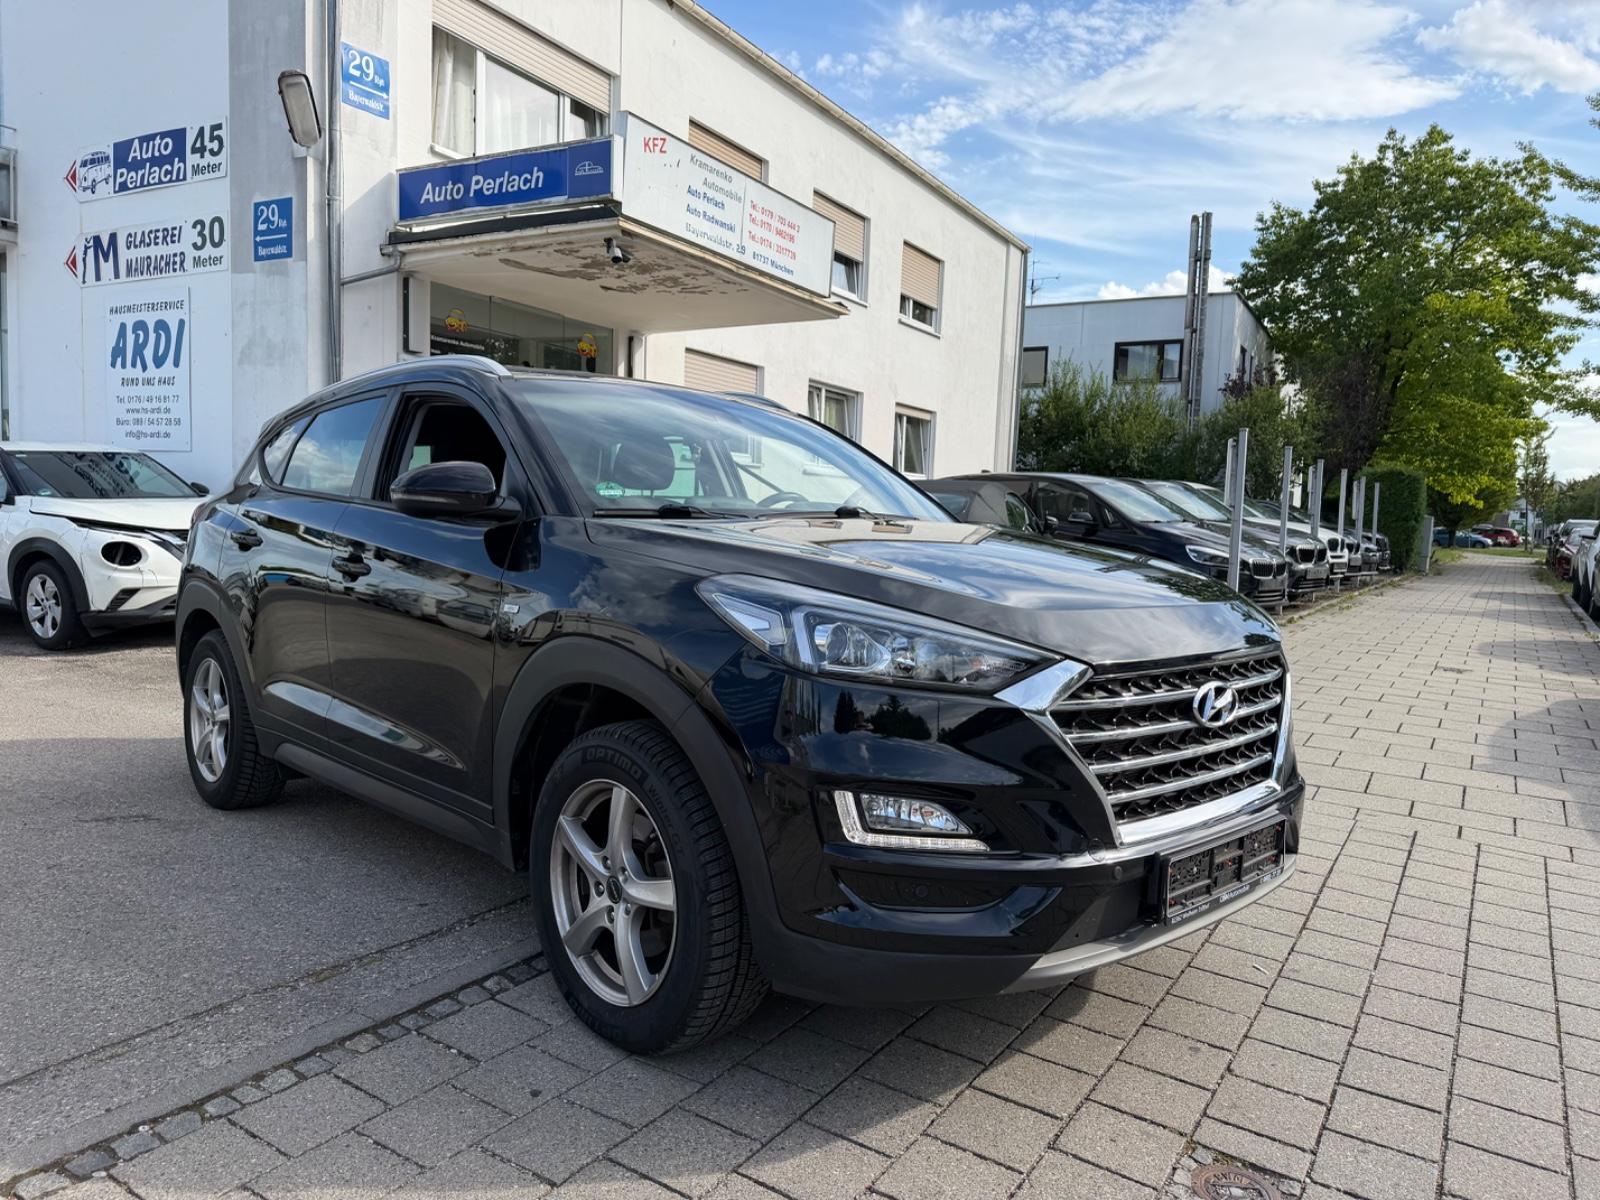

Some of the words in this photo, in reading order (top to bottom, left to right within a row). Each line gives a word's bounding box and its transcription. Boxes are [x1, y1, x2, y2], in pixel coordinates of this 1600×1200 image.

[349, 50, 374, 81] 29
[128, 134, 173, 162] Auto
[190, 123, 224, 159] 45
[643, 136, 667, 154] KFZ
[115, 158, 185, 191] Perlach
[191, 161, 223, 177] Meter
[690, 153, 733, 184] Kramarenko
[420, 181, 464, 204] Auto
[470, 166, 544, 197] Perlach
[686, 184, 702, 199] Auto
[702, 192, 725, 210] Perlach
[702, 177, 743, 203] Automobile
[257, 204, 279, 230] 29
[686, 203, 702, 218] Auto
[702, 210, 736, 233] Radwanski
[126, 225, 183, 250] GLASEREI
[191, 216, 225, 251] 30
[125, 251, 186, 278] MAURACHER
[192, 254, 224, 269] Meter
[770, 259, 795, 276] München
[109, 300, 185, 315] HAUSMEISTERSERVICE
[110, 318, 186, 373] ARDI
[120, 377, 140, 387] RUND
[141, 377, 155, 387] UMS
[157, 376, 176, 387] HAUS
